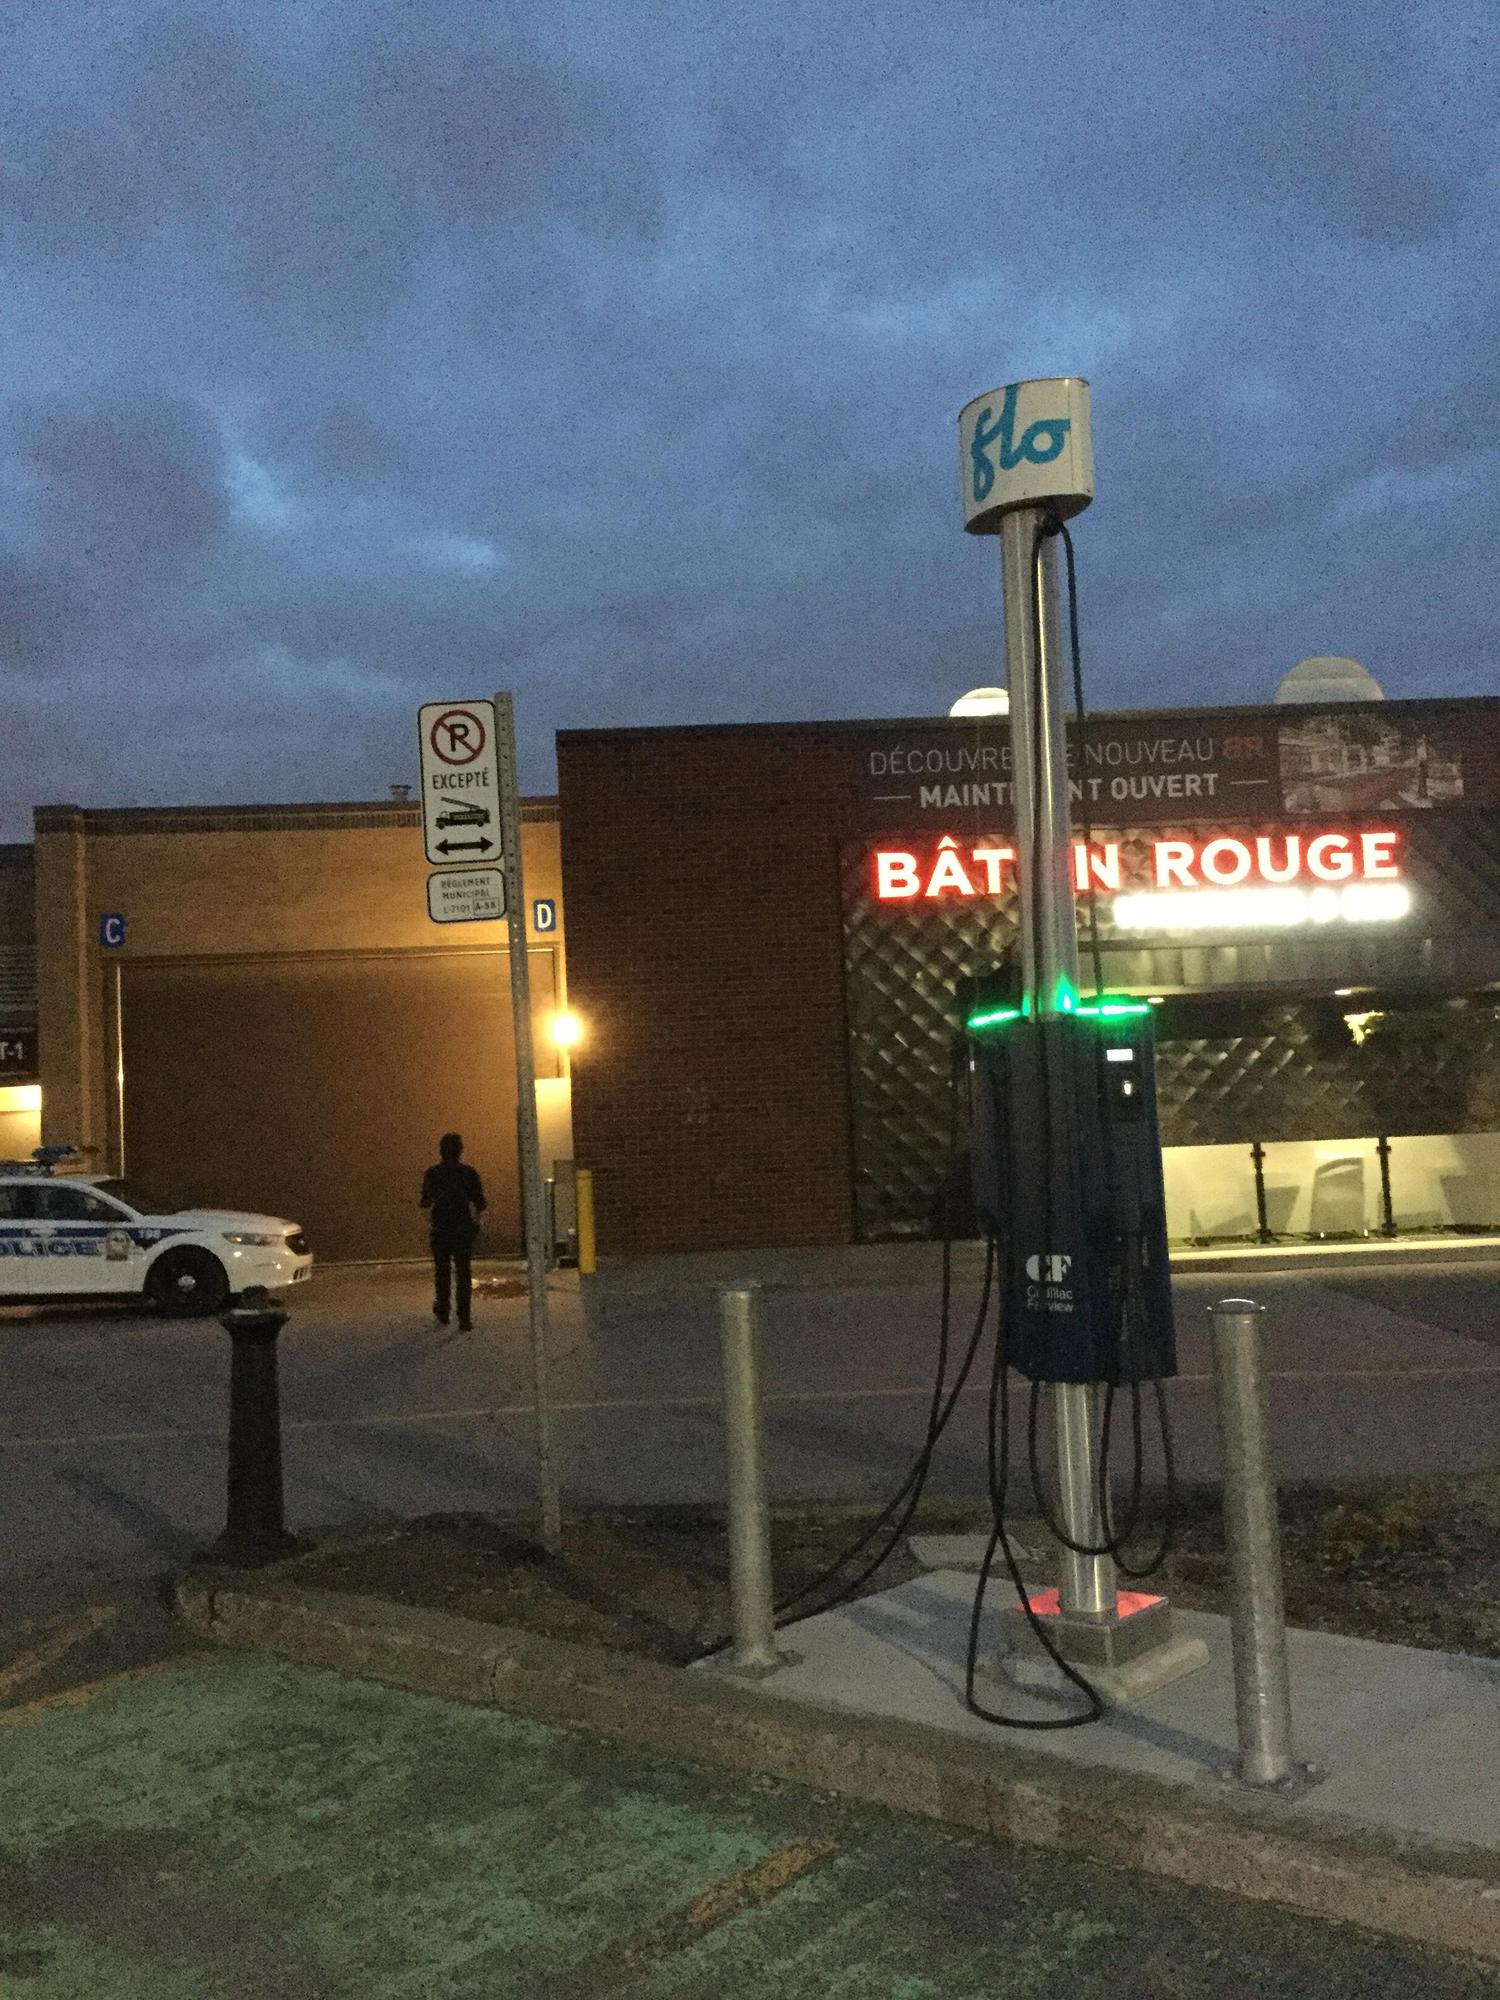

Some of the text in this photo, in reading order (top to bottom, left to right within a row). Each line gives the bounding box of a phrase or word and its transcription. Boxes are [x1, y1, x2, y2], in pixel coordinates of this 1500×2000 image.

[971, 383, 1071, 502] flo
[1085, 738, 1214, 766] NOUVEAU
[432, 767, 490, 790] EXCEPTÉ
[1111, 773, 1219, 801] OUVERT
[877, 832, 1399, 898] BÂTN ROUGE
[536, 903, 552, 930] D
[106, 919, 121, 943] C
